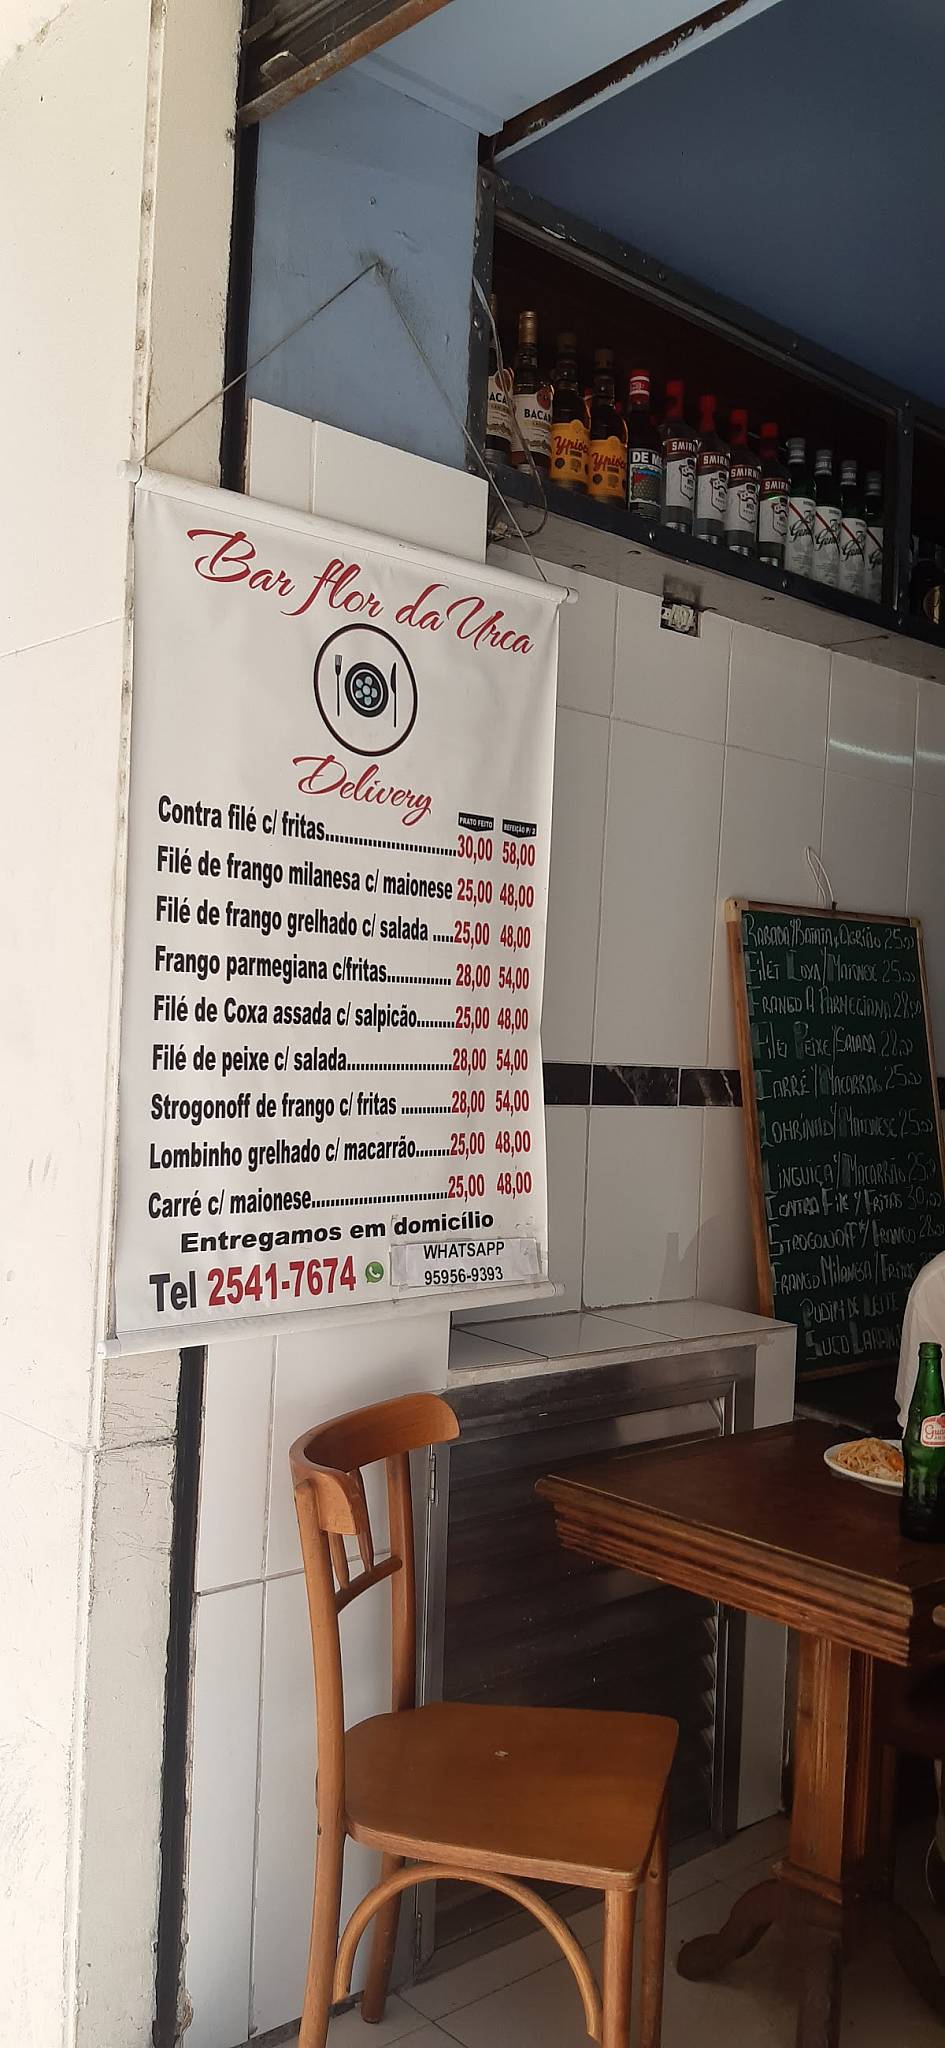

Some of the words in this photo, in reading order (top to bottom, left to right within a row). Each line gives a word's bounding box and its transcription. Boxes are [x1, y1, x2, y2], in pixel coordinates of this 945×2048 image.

[632, 452, 649, 464] DE
[186, 529, 295, 596] Bar
[280, 558, 384, 616] flor
[395, 584, 450, 632] da
[446, 596, 534, 654] Urca
[292, 755, 433, 826] Delivery
[158, 795, 222, 828] Contra
[228, 804, 257, 832] filé
[262, 809, 278, 835] c/
[457, 834, 493, 864] 30,00
[502, 841, 535, 869] 58,00
[460, 816, 477, 826] PRATO
[478, 819, 493, 829] FEITO
[157, 845, 192, 874] Filé
[198, 850, 221, 877] de
[227, 852, 283, 888] frango
[289, 861, 360, 890] milanesa
[365, 869, 379, 892] c/
[383, 872, 453, 899] maionese
[457, 878, 492, 907] 25,00
[500, 883, 534, 910] 48,00
[156, 895, 191, 924] Filé
[197, 899, 220, 925] de
[226, 901, 282, 936] frango
[287, 909, 357, 938] grelhado
[362, 913, 376, 938] c/
[380, 916, 428, 941] salada
[454, 920, 490, 949] 25,00
[500, 925, 531, 952] 48,00
[155, 945, 220, 980] Frango
[226, 954, 328, 984] parmegiana
[455, 963, 491, 991] 28,00
[498, 966, 529, 994] 54,00
[154, 994, 188, 1022] Filé
[194, 996, 218, 1022] de
[224, 997, 268, 1023] Coxa
[273, 1001, 332, 1025] assada
[336, 1002, 351, 1026] c/
[455, 1006, 490, 1034] 25,00
[497, 1008, 529, 1035] 48,00
[152, 1044, 187, 1071] Filé
[193, 1045, 216, 1071] de
[222, 1045, 269, 1077] peixe
[274, 1046, 289, 1071] c/
[452, 1048, 486, 1076] 28,00
[496, 1049, 528, 1076] 54,00
[151, 1093, 251, 1126] Strogonoff
[256, 1093, 277, 1118] de
[281, 1092, 335, 1123] frango
[339, 1092, 353, 1116] c/
[357, 1092, 397, 1115] fritas
[452, 1090, 486, 1117] 28,00
[495, 1089, 529, 1117] 54,00
[149, 1141, 242, 1169] Lombinho
[248, 1138, 320, 1172] grelhado
[325, 1137, 340, 1161] c/
[450, 1132, 485, 1160] 25,00
[495, 1130, 531, 1157] 48,00
[148, 1190, 202, 1218] Carré
[208, 1189, 225, 1215] c/
[448, 1174, 485, 1202] 25,00
[496, 1171, 532, 1199] 48,00
[181, 1226, 342, 1253] Entregamos
[350, 1222, 386, 1239] em
[394, 1211, 494, 1235] domicílio
[424, 1241, 505, 1259] WHATSAPP
[149, 1271, 197, 1312] Tel
[207, 1255, 356, 1307] 2541-7674
[424, 1266, 503, 1285] 95956-9393
